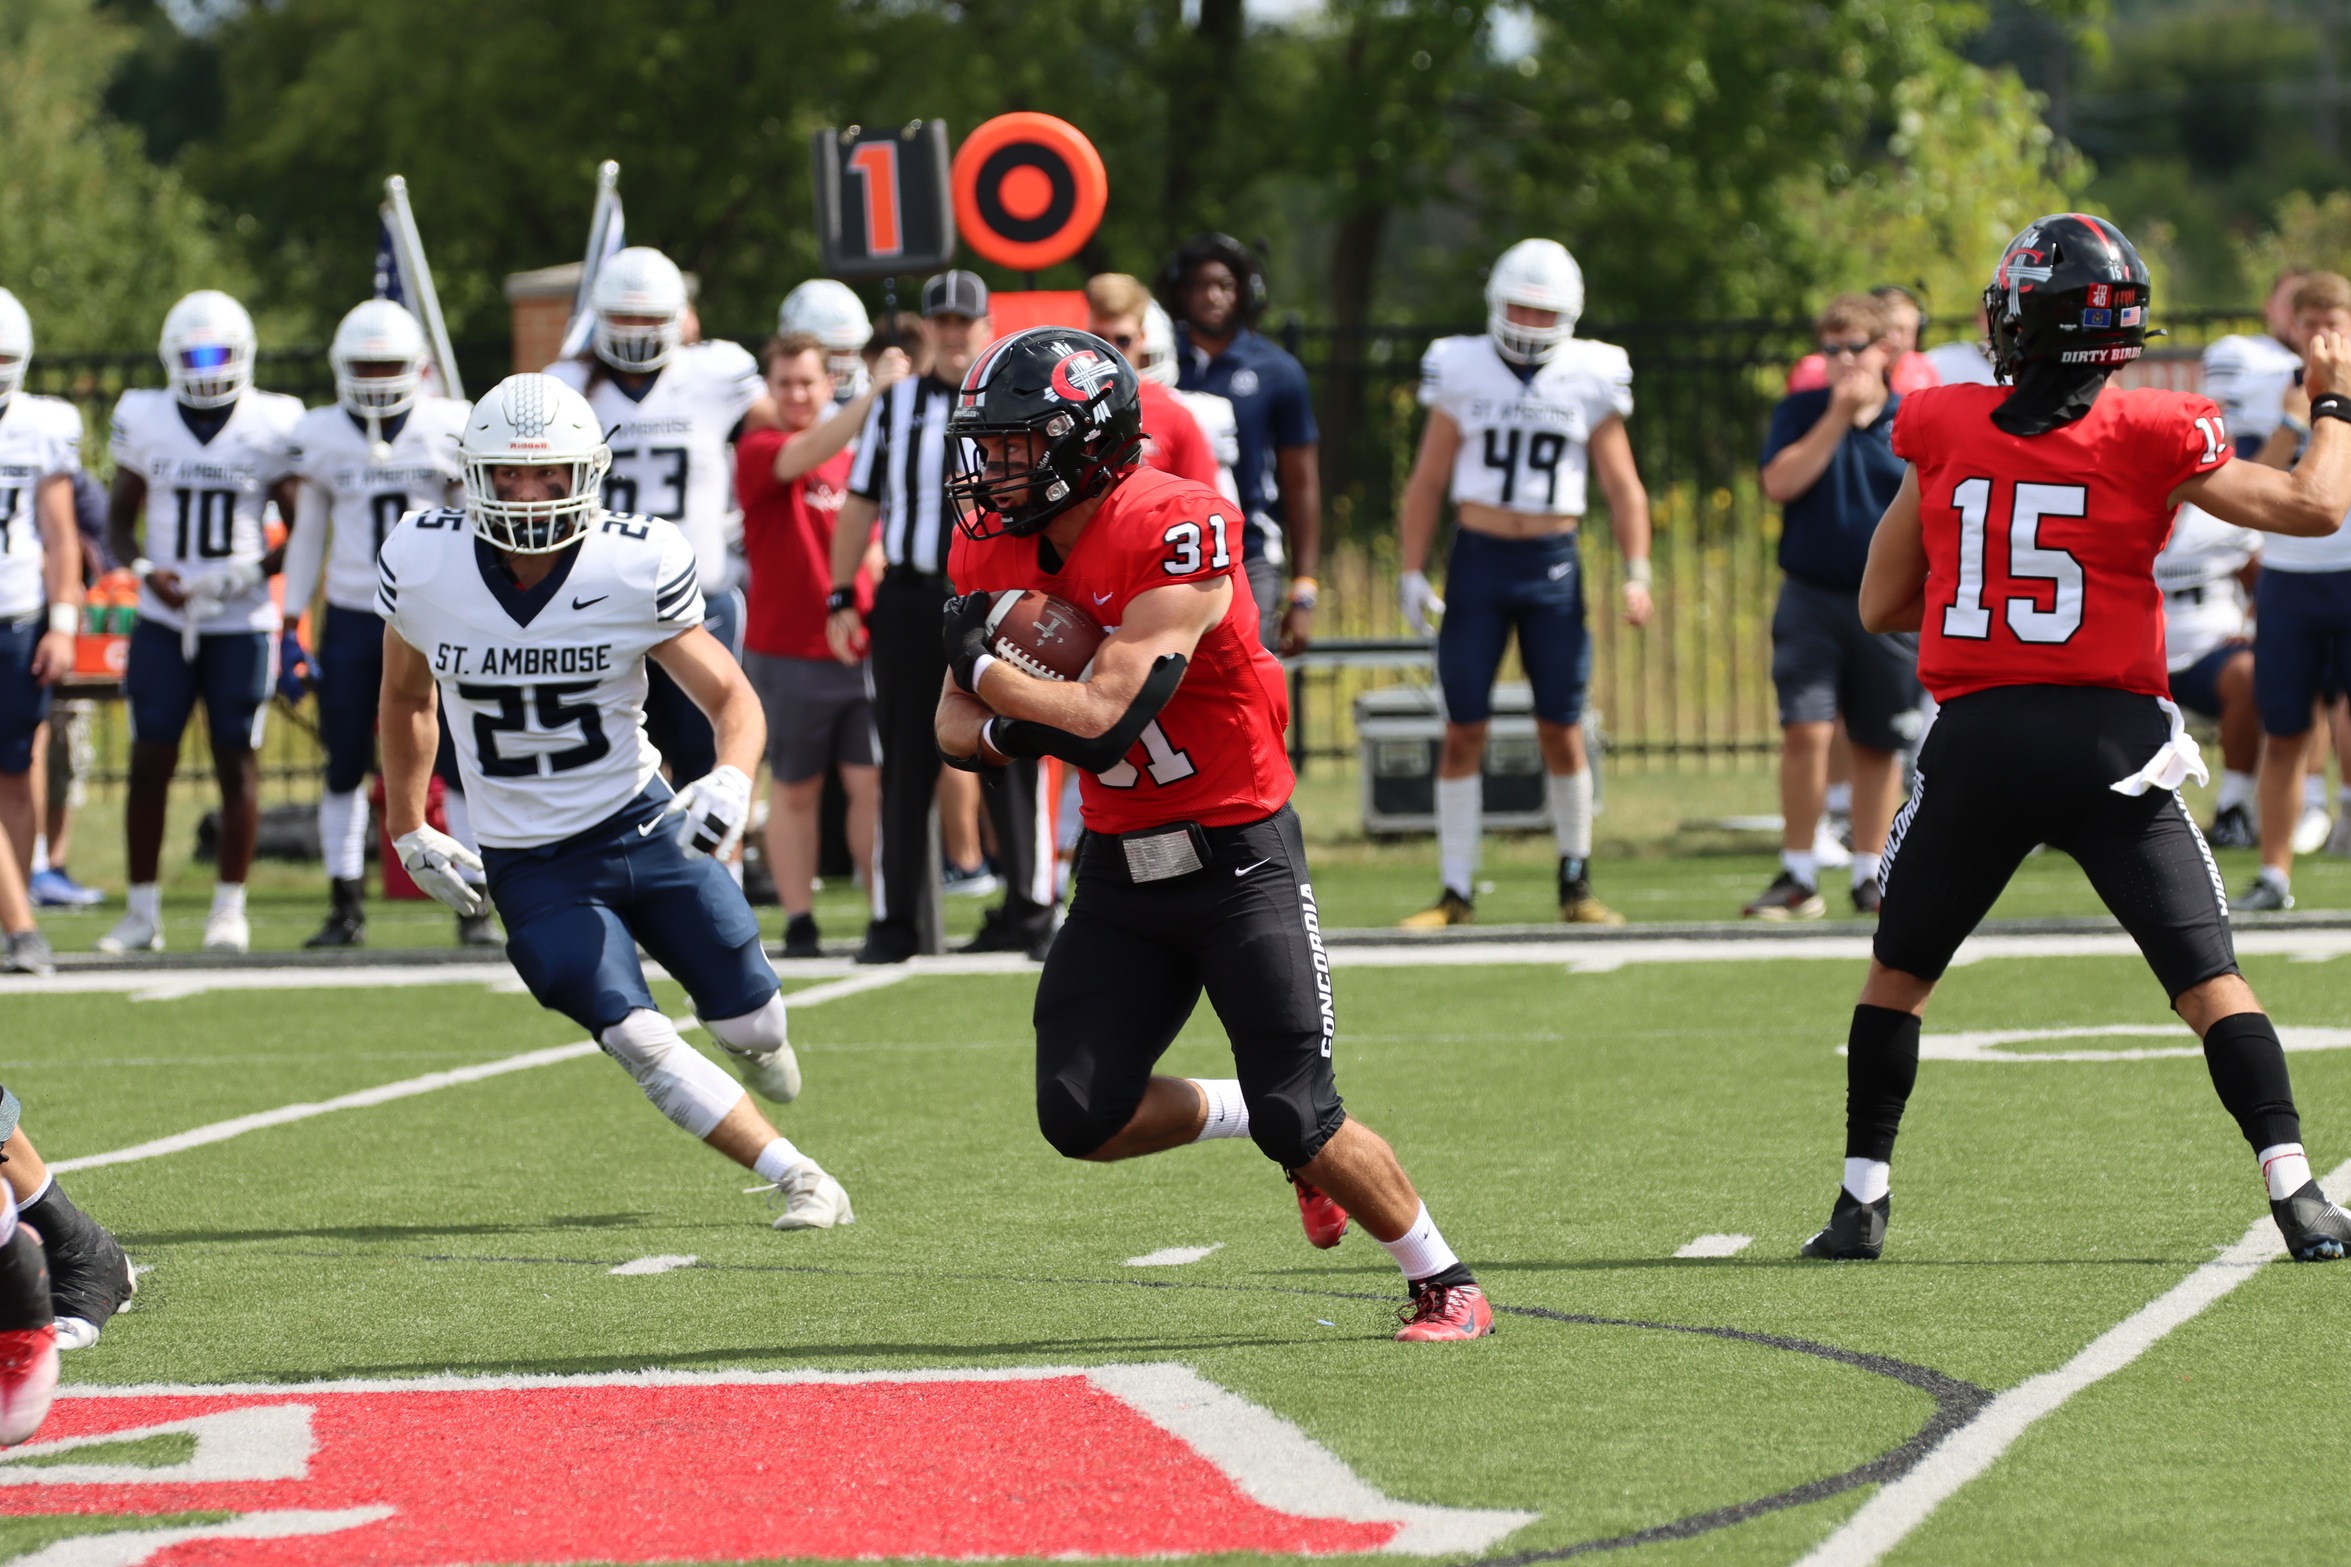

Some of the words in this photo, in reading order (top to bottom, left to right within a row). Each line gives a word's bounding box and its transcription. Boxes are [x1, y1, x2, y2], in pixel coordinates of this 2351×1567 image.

[846, 140, 904, 256] 1
[2108, 265, 2123, 281] 15
[2061, 350, 2110, 363] DIRTY
[2110, 346, 2143, 362] BIRDS
[510, 442, 547, 450] Riddell
[1484, 427, 1566, 505] 49
[174, 487, 236, 561] 10
[1162, 513, 1230, 575] 31
[1941, 476, 2088, 645] 15
[435, 643, 470, 675] ST.
[480, 644, 611, 675] AMBROSE
[456, 679, 611, 777] 25
[1300, 883, 1335, 1059] CONCORDIA
